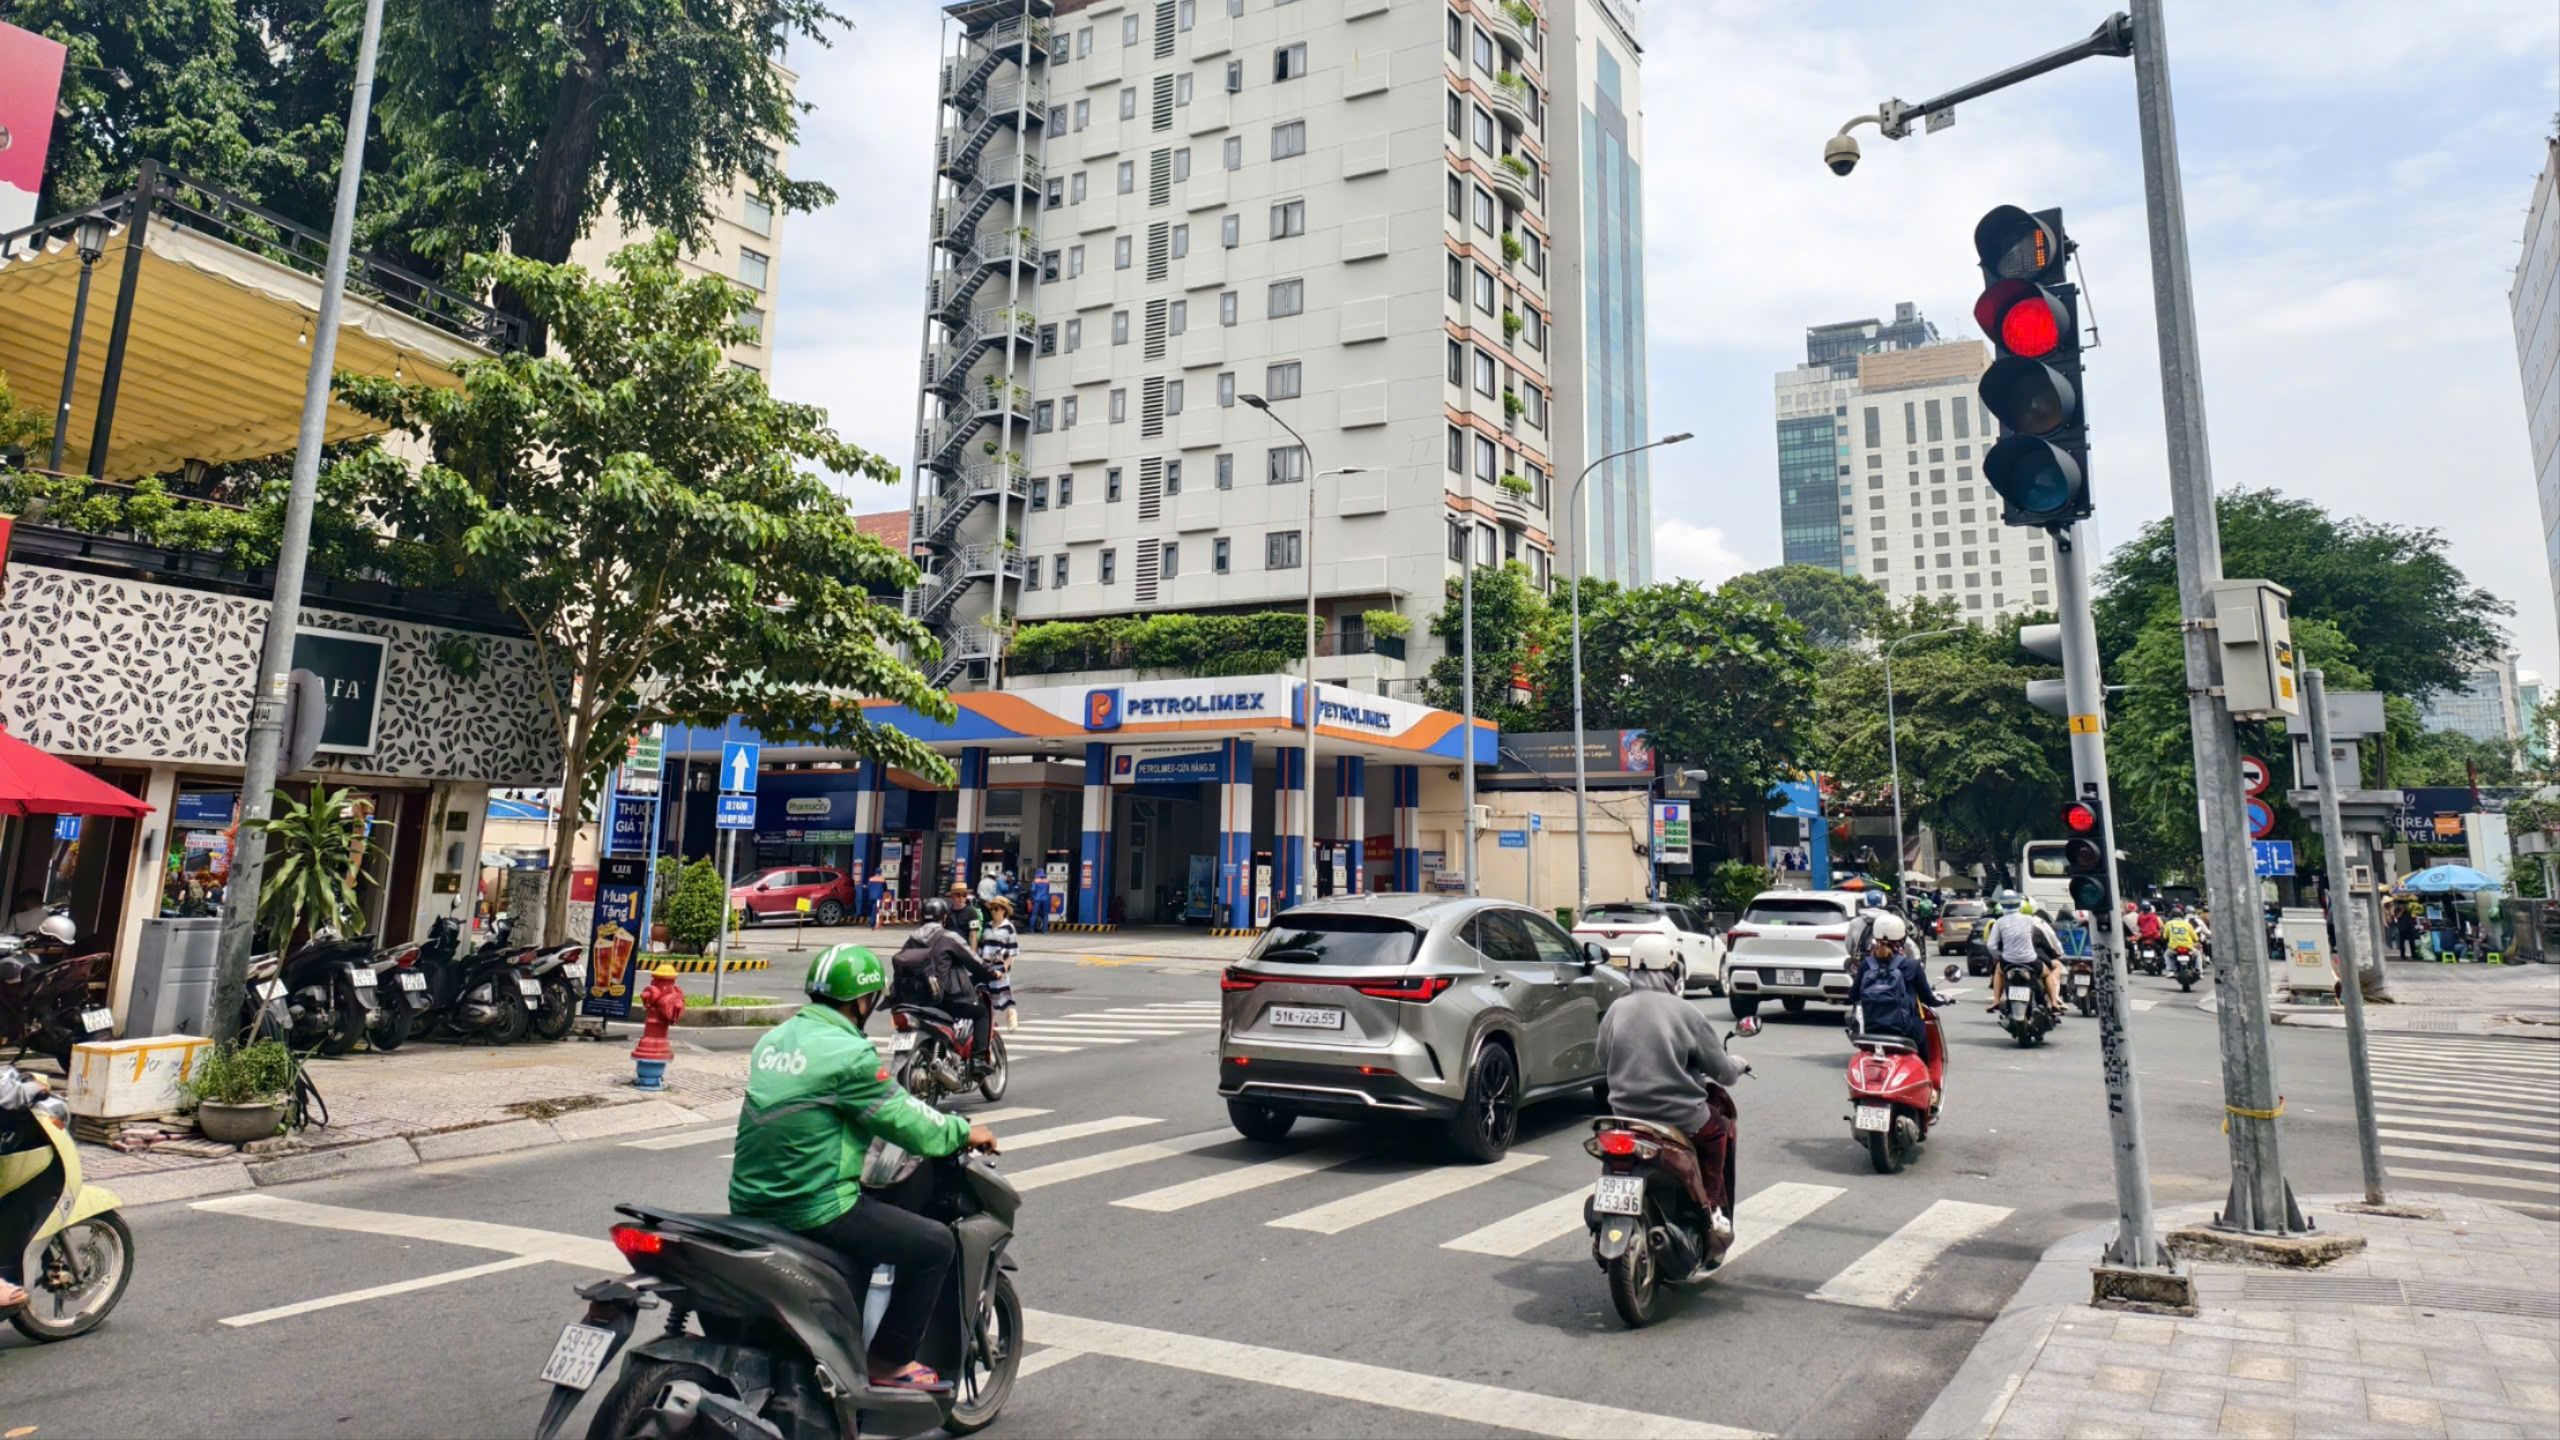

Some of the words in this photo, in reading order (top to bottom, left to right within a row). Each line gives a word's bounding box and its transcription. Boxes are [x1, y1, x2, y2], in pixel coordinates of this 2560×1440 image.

[1127, 692, 1265, 716] PETROLIMEX
[2078, 717, 2085, 731] 1
[788, 800, 829, 812] Pharmacity
[602, 889, 628, 903] Mua
[629, 890, 638, 920] 1
[857, 969, 880, 985] Grab
[1275, 1010, 1337, 1025] 51K-729.55
[758, 1045, 807, 1075] Grab
[1602, 1179, 1635, 1195] 59-K2
[1596, 1194, 1638, 1212] 453.96
[561, 1327, 604, 1358] 59-F2
[546, 1353, 596, 1384] 487.37
